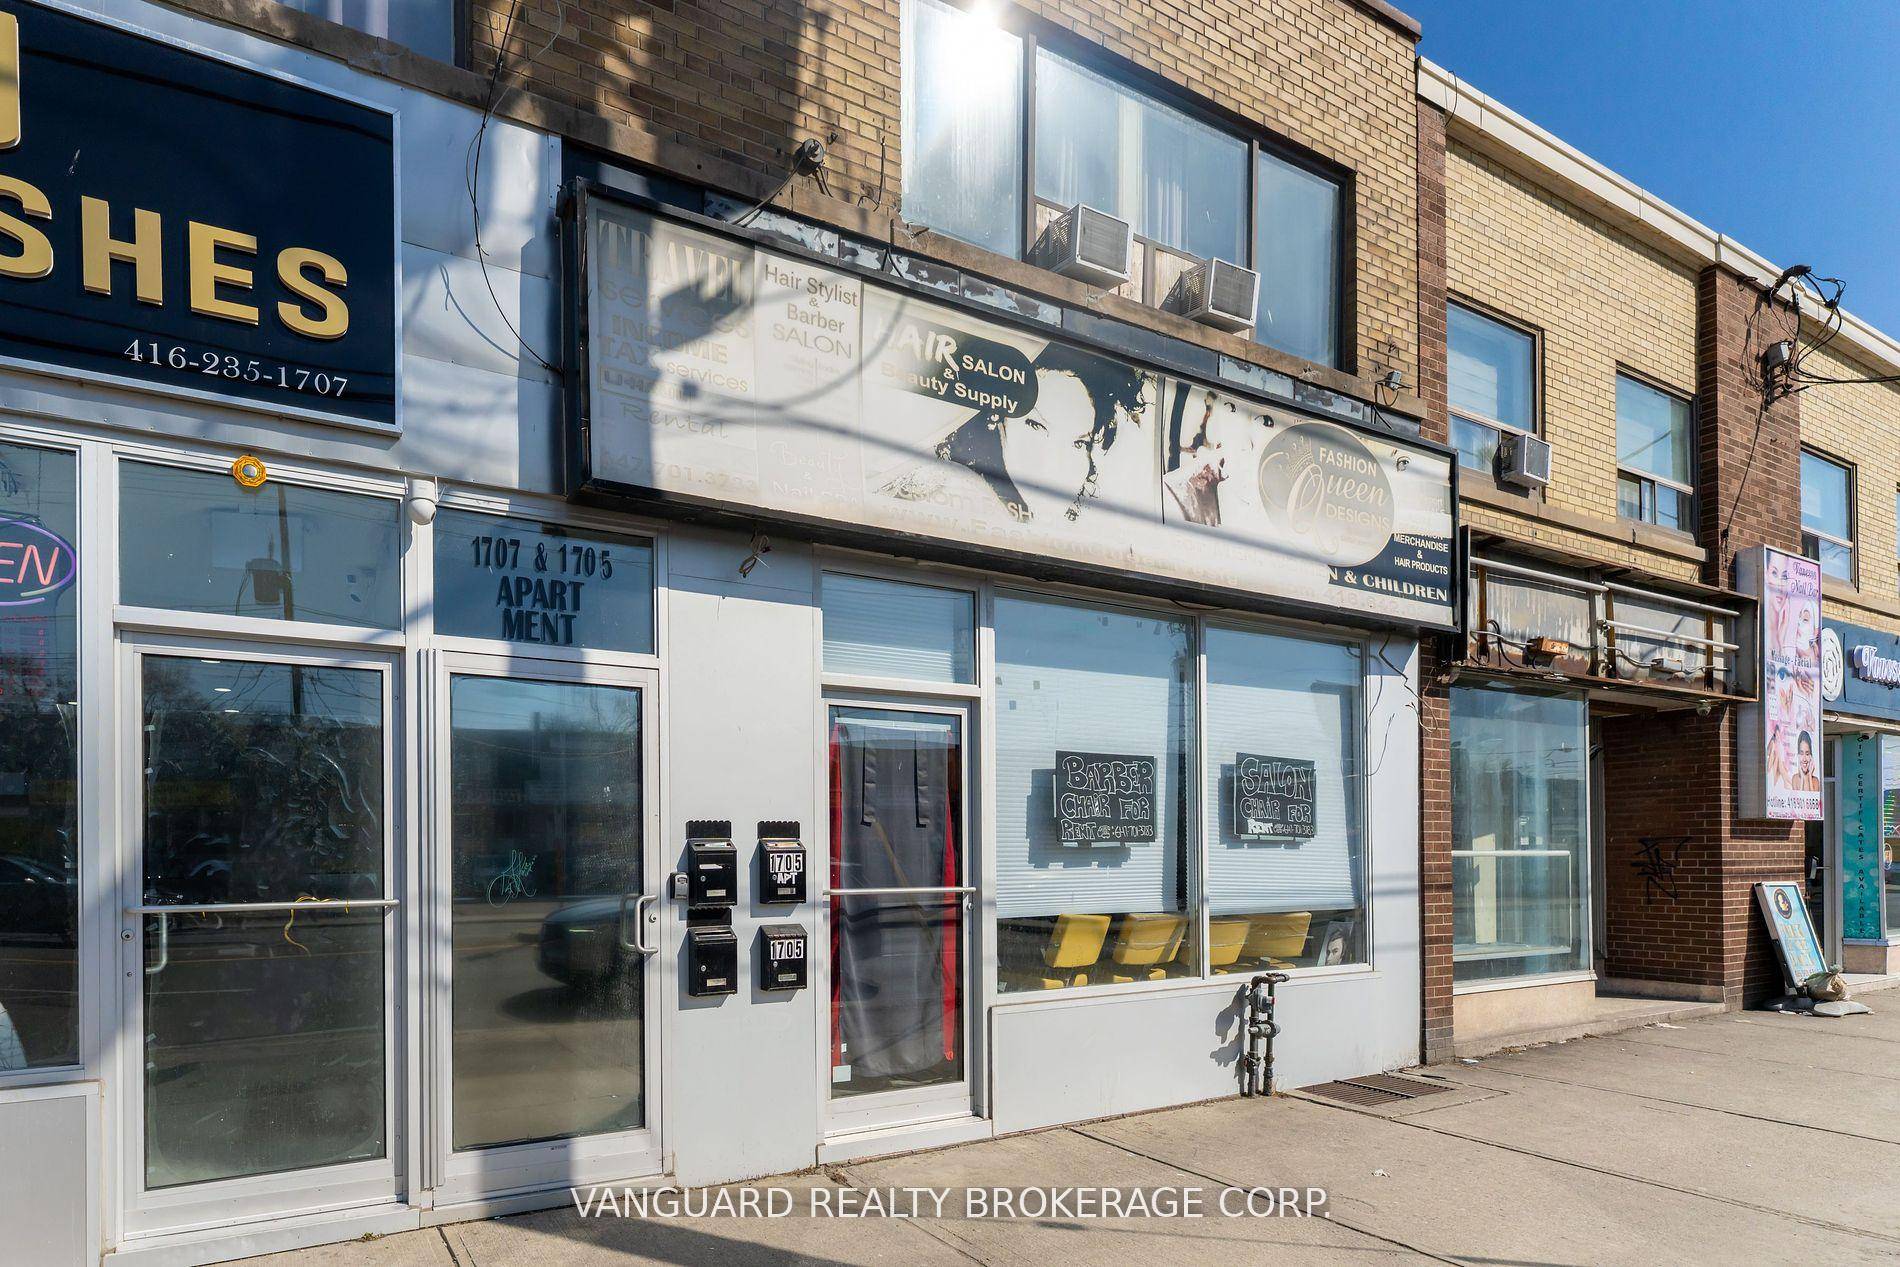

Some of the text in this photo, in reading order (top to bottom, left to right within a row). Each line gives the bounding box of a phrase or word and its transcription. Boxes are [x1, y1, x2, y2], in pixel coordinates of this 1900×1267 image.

[765, 264, 858, 307] Hair Stylist
[809, 297, 819, 307] &
[787, 302, 845, 333] Barber
[773, 324, 852, 360] SALON
[124, 339, 348, 397] 416-235-1707
[667, 361, 748, 393] services
[943, 368, 954, 380] &
[962, 355, 1026, 385] SALON
[954, 382, 1018, 413] Supply
[1319, 448, 1377, 477] FASHION
[1266, 457, 1389, 546] Queen
[1326, 503, 1391, 532] DESIGNS
[1394, 533, 1449, 553] MERCHANDISE
[1417, 550, 1424, 559] &
[472, 536, 613, 580] 1707 & 1705
[1395, 557, 1448, 575] HAIR PRODUCTS
[496, 575, 584, 612] APART
[1344, 570, 1357, 584] &
[1362, 574, 1448, 602] CHILDREN
[502, 608, 577, 644] MENT
[1062, 756, 1154, 794] BARBER
[1241, 758, 1312, 802] SALON
[1119, 797, 1149, 820] FOR
[1288, 804, 1311, 823] FOR
[1061, 819, 1096, 840] RENT
[1247, 819, 1273, 834] RENT
[771, 855, 801, 871] 1705
[776, 872, 797, 884] APT
[771, 941, 801, 958] 1705
